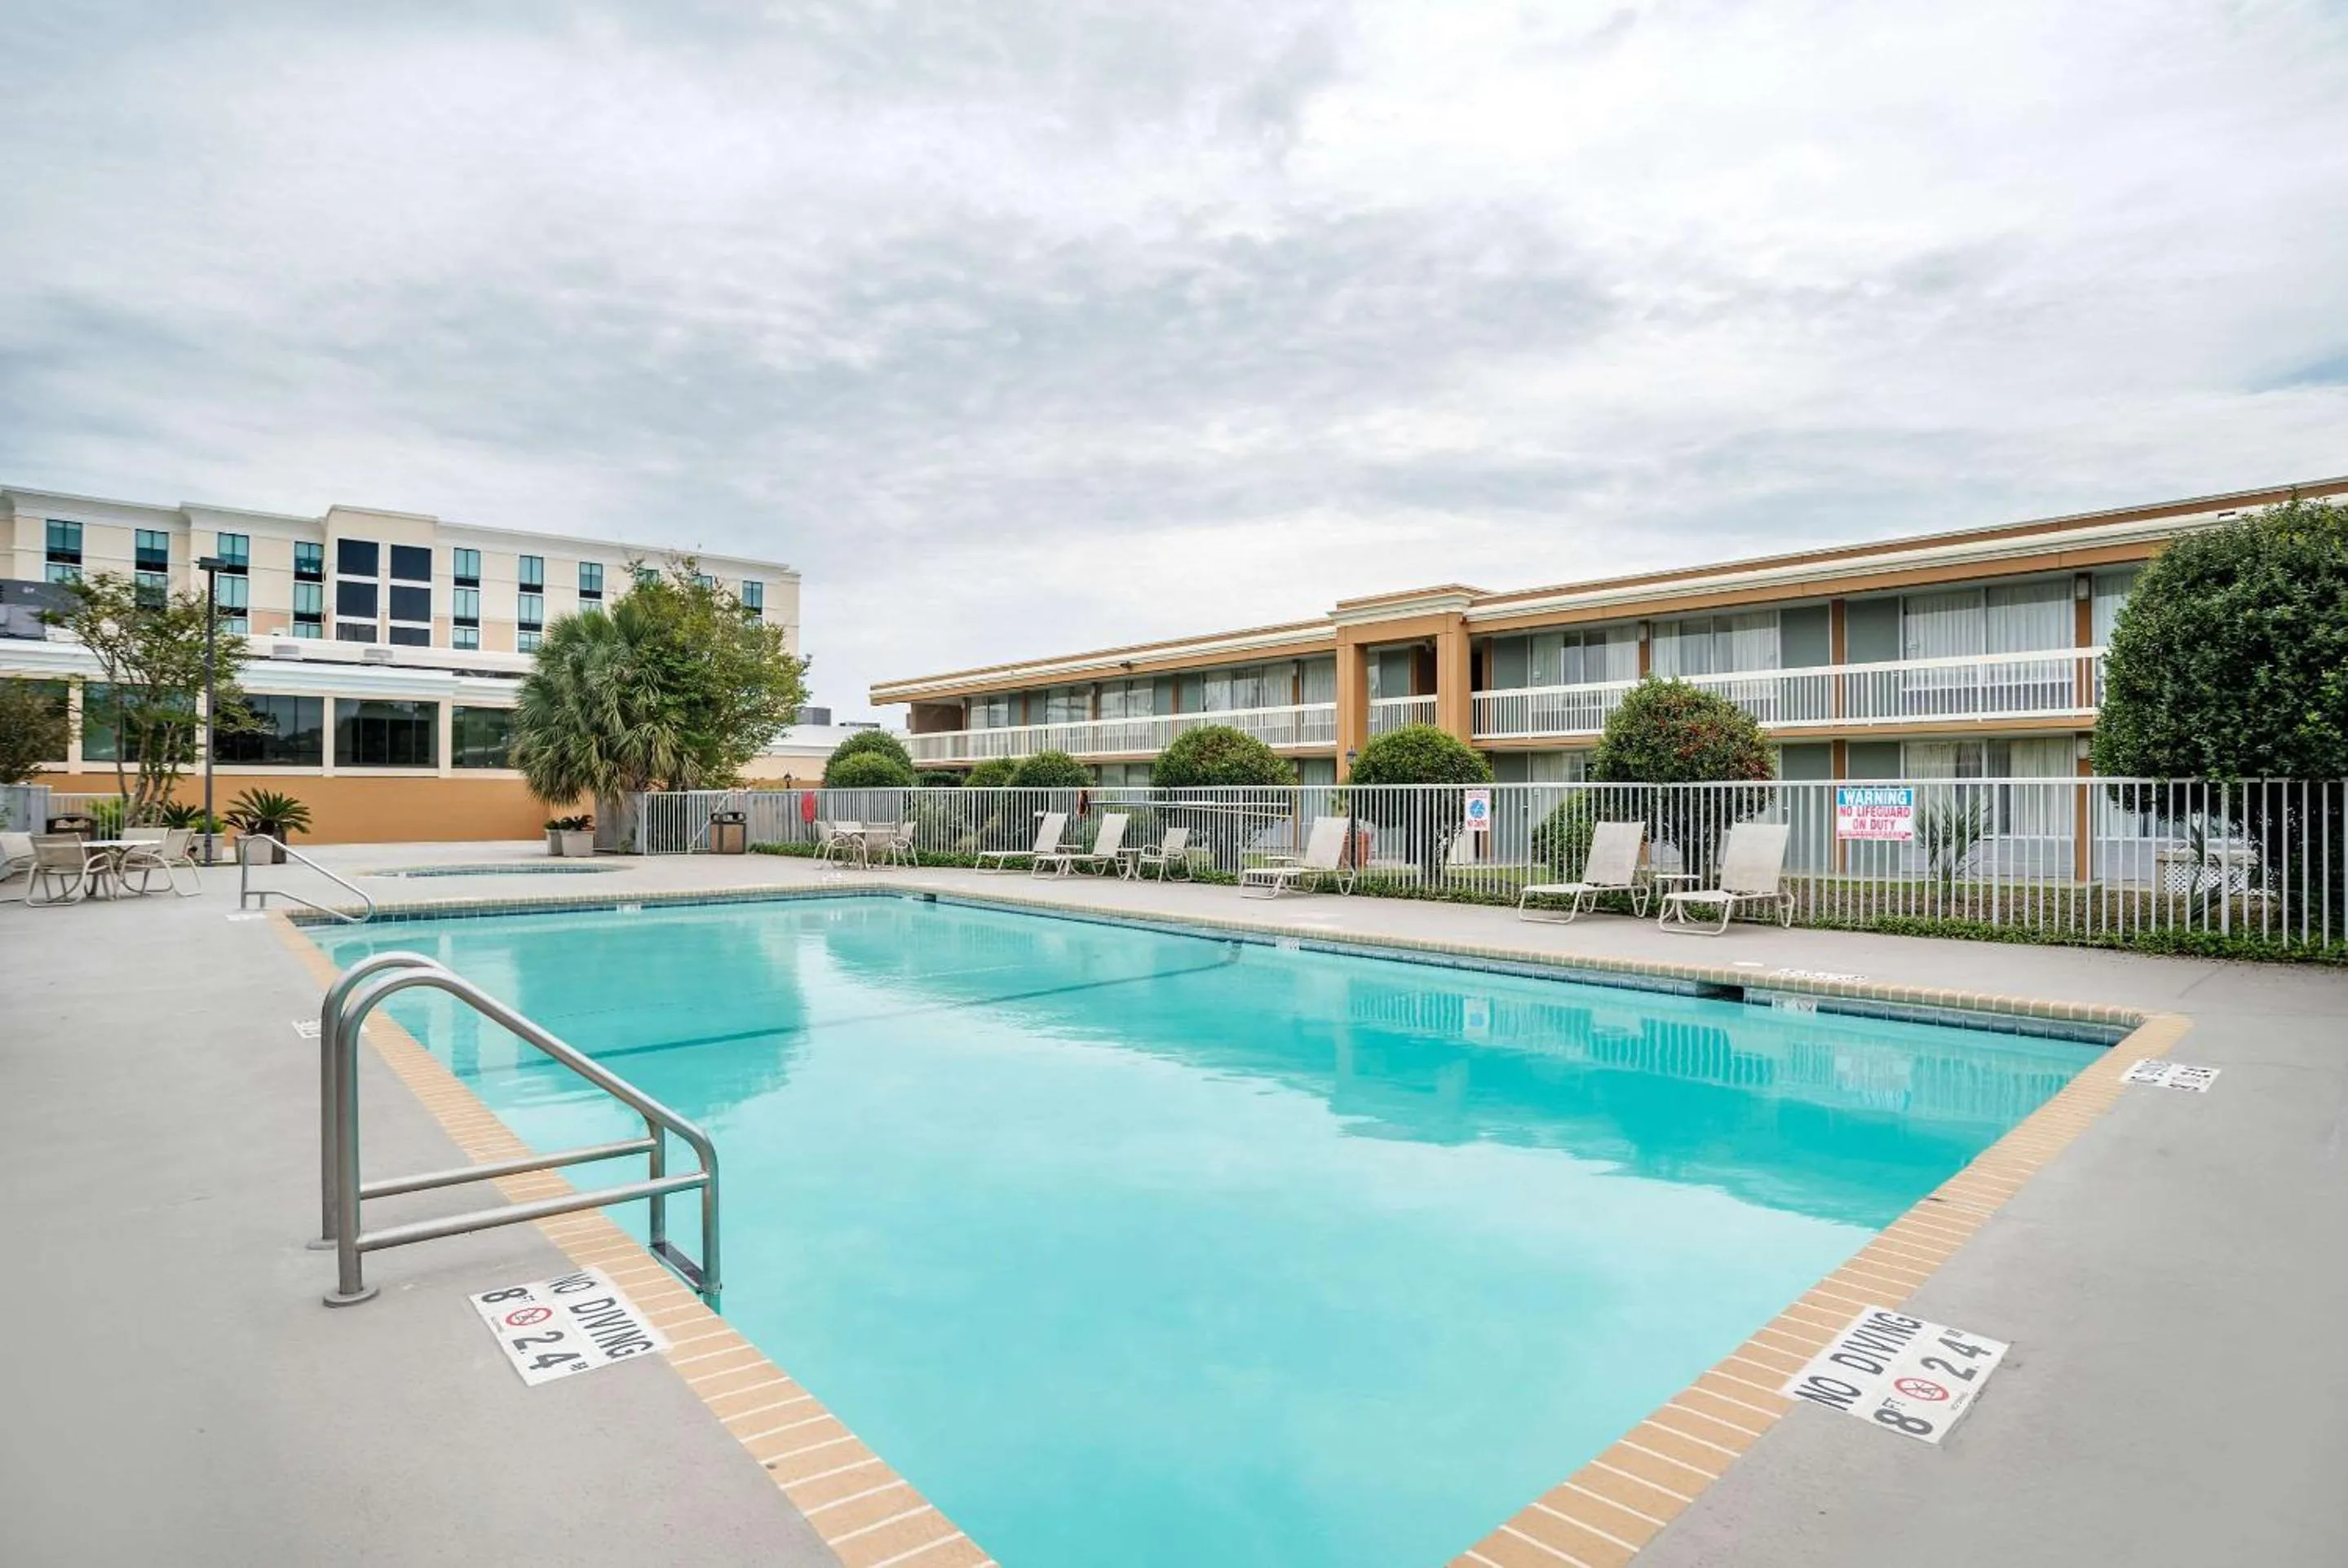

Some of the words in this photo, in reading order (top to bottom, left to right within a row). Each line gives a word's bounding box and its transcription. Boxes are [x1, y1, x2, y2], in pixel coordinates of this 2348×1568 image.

[1844, 790, 1907, 805] WARNING
[1840, 806, 1852, 816] NO
[1856, 806, 1910, 817] LIFEGUARD
[1853, 819, 1866, 830] ON
[1870, 819, 1896, 830] DUTY
[548, 1271, 597, 1294] NO
[568, 1296, 653, 1358] DIVING
[1793, 1376, 1862, 1411] NO
[1829, 1311, 1922, 1375] DIVING
